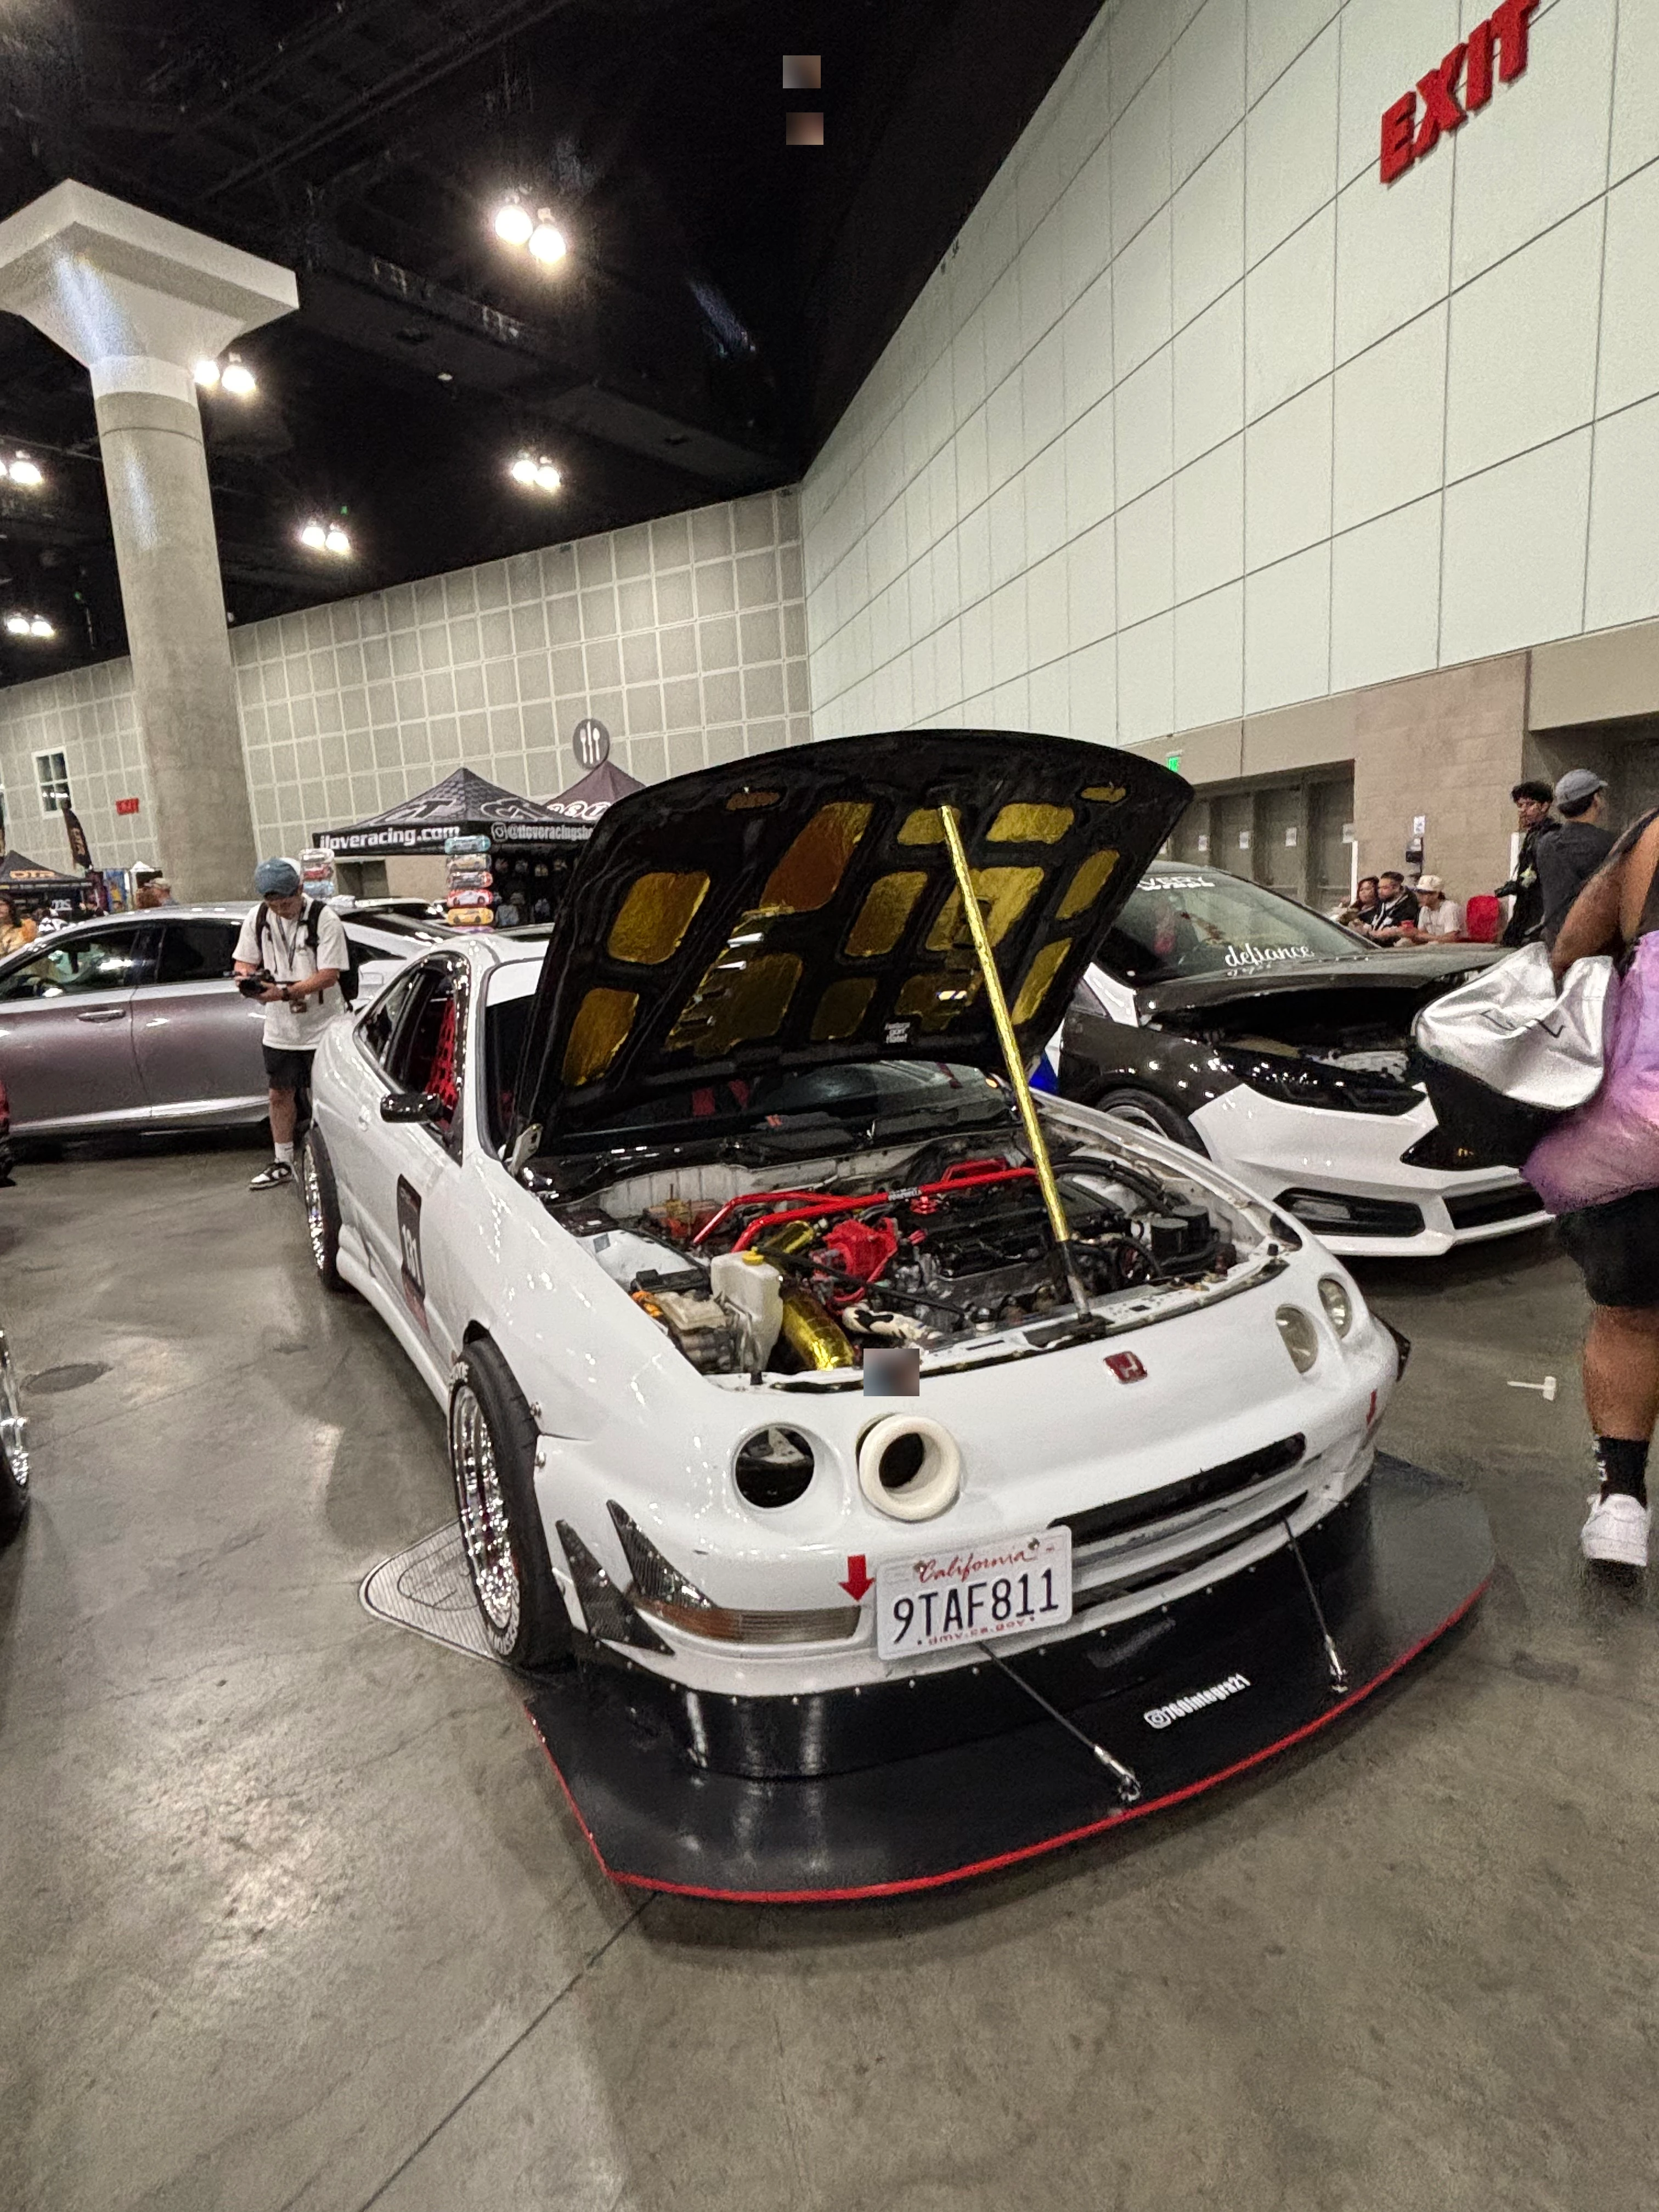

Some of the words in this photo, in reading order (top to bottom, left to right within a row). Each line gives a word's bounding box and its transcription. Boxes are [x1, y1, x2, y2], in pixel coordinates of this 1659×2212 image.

[1380, 0, 1539, 185] EXIT
[319, 826, 460, 850] iloveracing.com
[1224, 943, 1315, 967] defiance
[919, 1551, 1037, 1583] California
[893, 1567, 1059, 1645] 9TAF811
